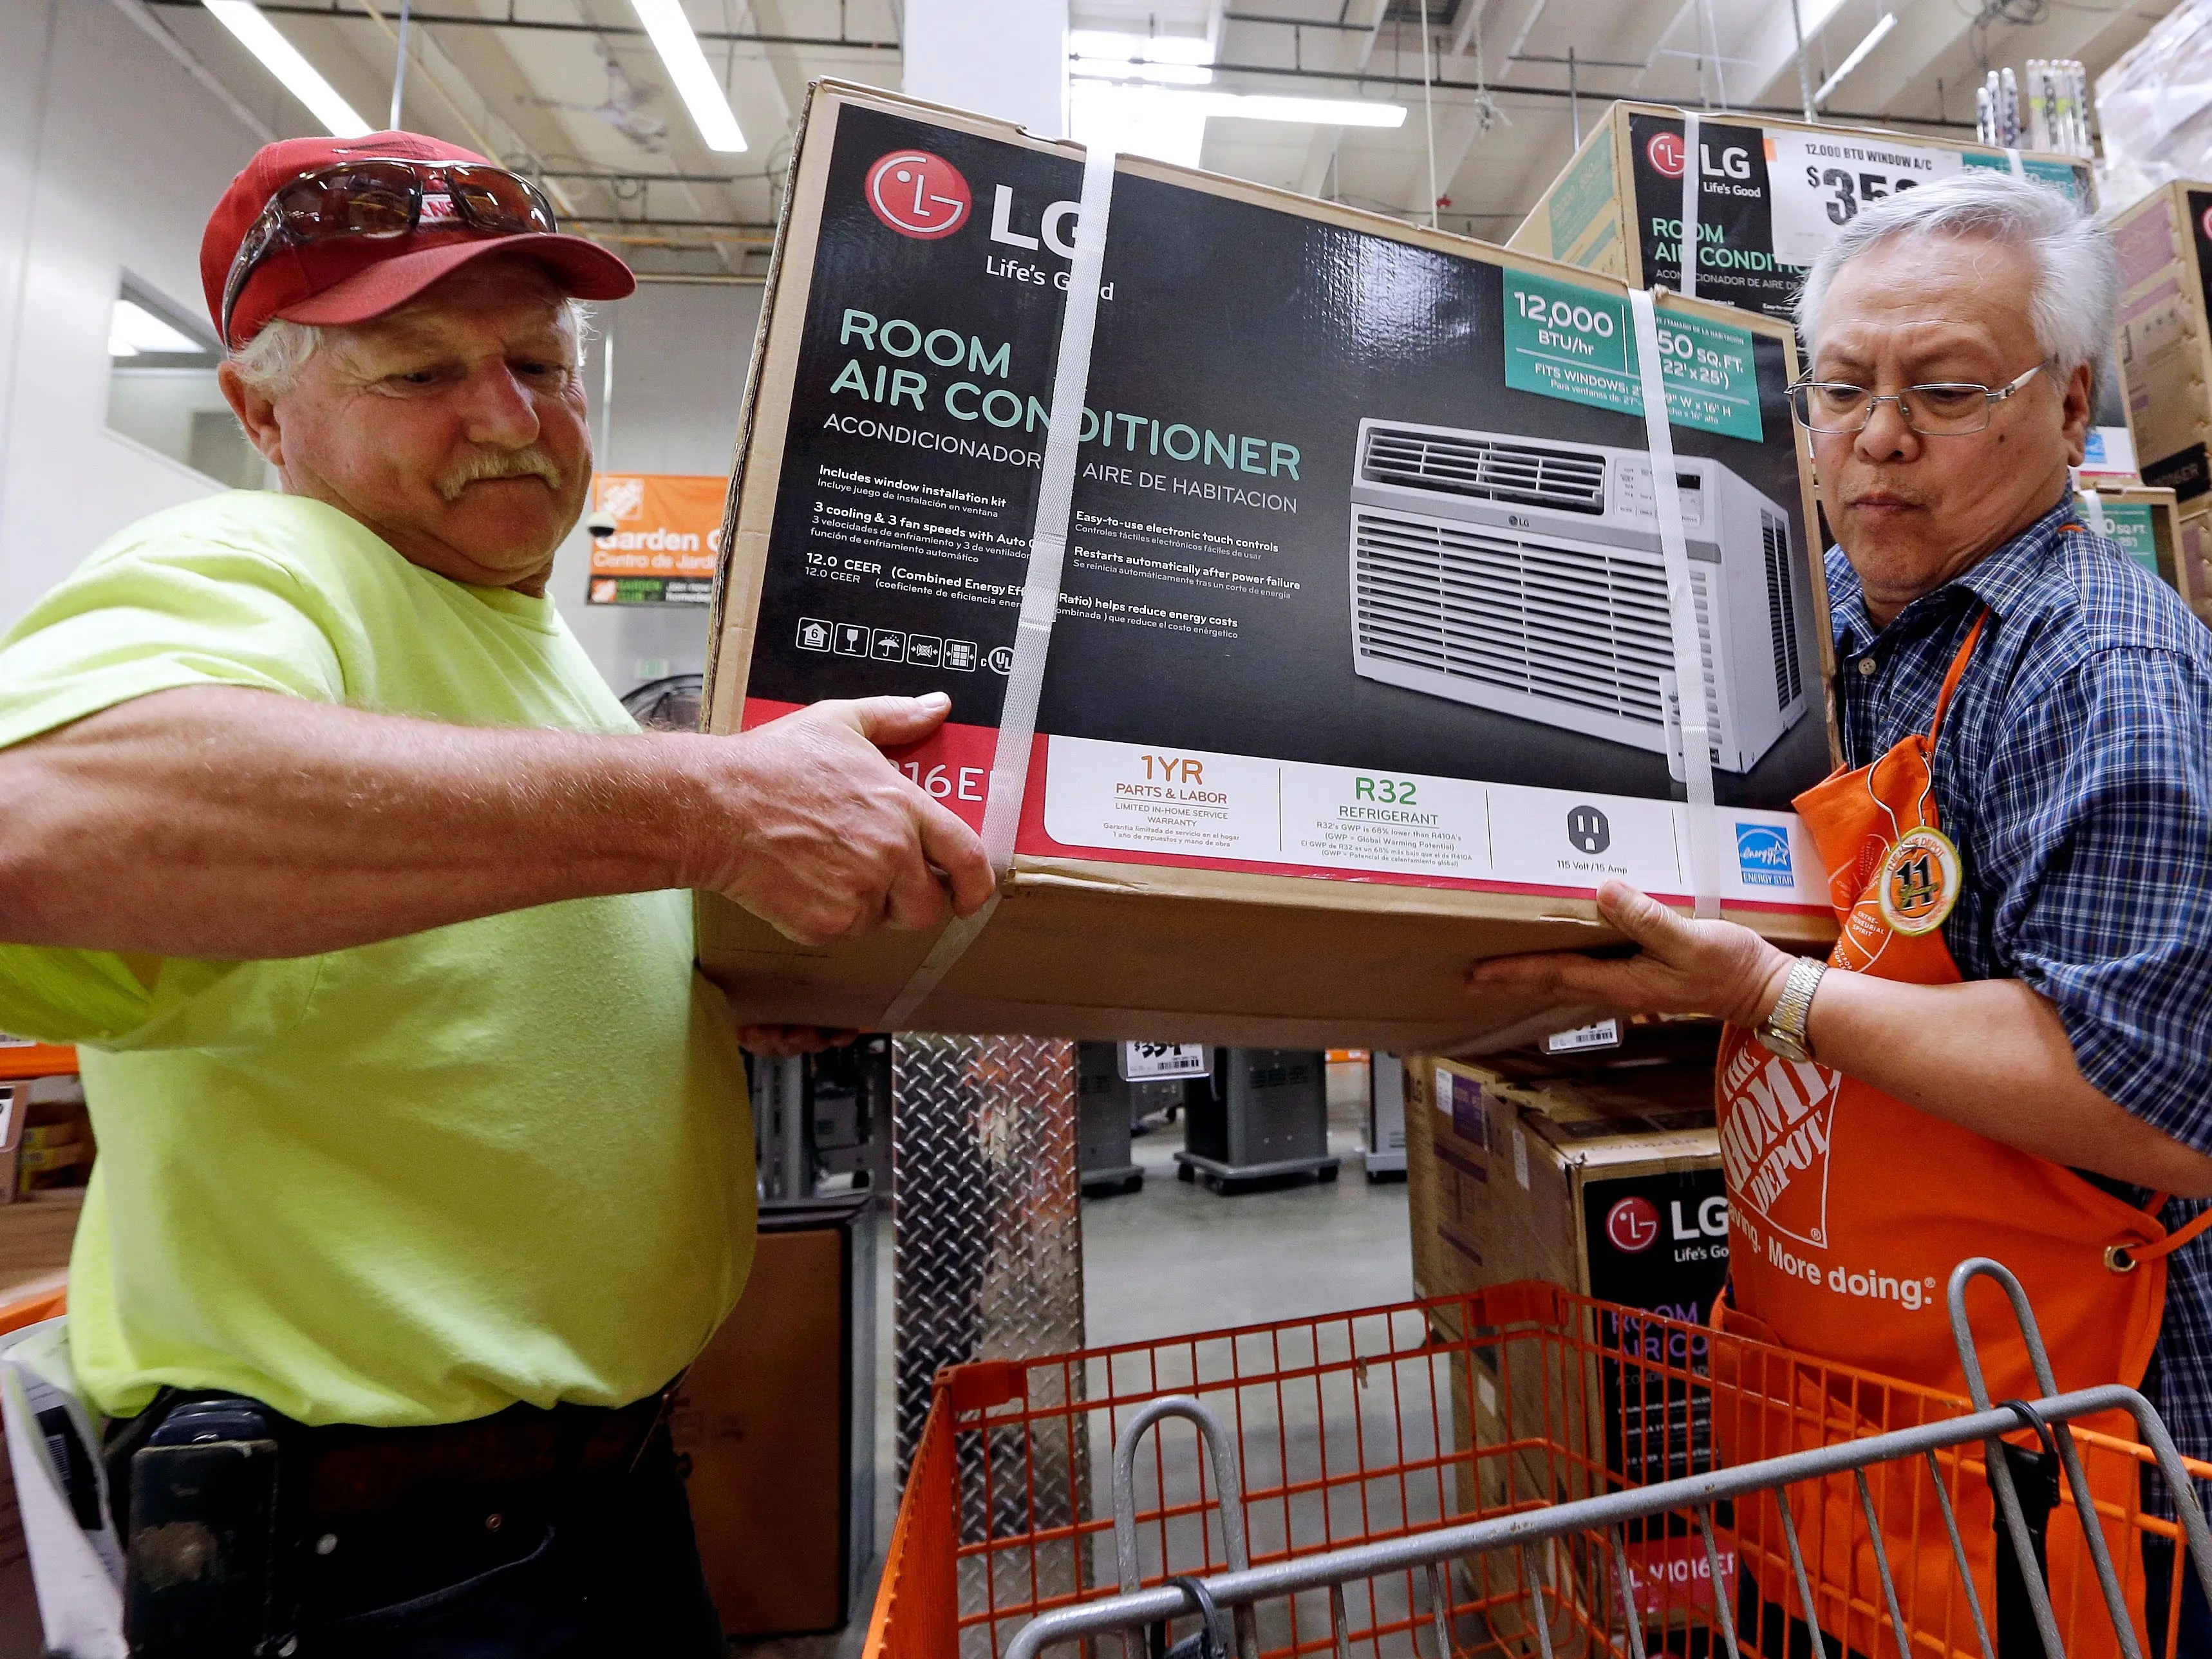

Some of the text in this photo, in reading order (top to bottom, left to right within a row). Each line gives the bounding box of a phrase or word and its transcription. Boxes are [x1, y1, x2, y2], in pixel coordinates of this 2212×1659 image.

[1700, 143, 1751, 180] LG
[1844, 148, 1864, 160] BTU
[1866, 150, 1911, 167] WINDOW
[1913, 158, 1933, 171] A/C
[1703, 181, 1761, 198] Life's Good
[986, 256, 1114, 302] Life's Gd
[1762, 279, 1784, 290] AIRE
[840, 308, 1011, 379] ROOM
[1514, 291, 1613, 338] 12,000
[1658, 329, 1694, 360] 50
[1538, 329, 1595, 356] BTU/hr
[830, 359, 927, 411] AIR
[1535, 362, 1561, 379] FITS
[1680, 396, 1692, 408] W
[823, 413, 1297, 514] ACONDICIONADOR AIRE DE HABITACION
[818, 478, 852, 492] Incluye
[852, 485, 881, 498] juego
[883, 491, 895, 500] de
[897, 493, 947, 509] instalación
[962, 507, 998, 518] ventana
[820, 464, 1007, 507] Includes window installation kit
[812, 515, 820, 524] 3
[821, 518, 878, 535] velocidades
[879, 528, 892, 537] de
[894, 532, 954, 548] enfriamiento
[963, 541, 970, 550] 3
[971, 543, 984, 552] de
[814, 501, 823, 512] 3
[826, 507, 872, 523] cooling
[874, 512, 885, 523] &
[888, 515, 897, 525] 3
[900, 517, 921, 530] fan
[923, 523, 966, 538] speeds
[968, 530, 994, 542] with
[996, 534, 1026, 547] Auto
[1074, 523, 1261, 561] Controles táctiles electrónicos fáciles de usar
[1076, 511, 1279, 552] Easy-to-use electronic touch controls
[810, 528, 979, 563] función de enfriamiento automático
[1073, 559, 1085, 568] Se
[1087, 563, 1118, 573] reinicia
[1119, 568, 1194, 585] automáticamente
[1196, 579, 1212, 587] tras
[1226, 584, 1248, 593] corte
[1248, 586, 1259, 595] de
[1074, 546, 1300, 590] Restarts automatically after power failure
[805, 567, 828, 578] 12.0
[830, 571, 861, 583] CEER
[876, 578, 933, 595] (coeficiente
[935, 588, 948, 597] de
[951, 591, 996, 605] eficiencia
[1109, 615, 1125, 624] que
[1127, 617, 1157, 628] reduce
[1168, 623, 1192, 632] costo
[807, 552, 838, 567] 12.0
[844, 559, 881, 574] CEER
[892, 567, 961, 587] (Combined
[965, 578, 1006, 596] Energy
[1059, 592, 1092, 608] Ratio)
[1094, 597, 1125, 612] helps
[1128, 605, 1167, 618] reduce
[1169, 611, 1207, 625] energy
[1208, 615, 1238, 628] costs
[1141, 755, 1203, 785] 1YR
[1116, 783, 1228, 804] PARTS & LABOR
[1355, 776, 1417, 805] R32
[1115, 802, 1228, 820] LIMITED IN-HOME SERVICE
[1147, 816, 1197, 827] WARRANTY
[1339, 805, 1438, 825] REFRIGERANT
[1357, 835, 1382, 844] Global
[1383, 838, 1417, 848] Warming
[1391, 829, 1411, 838] lower
[1557, 859, 1571, 869] 115
[1608, 864, 1627, 876] Amp
[1750, 1110, 1828, 1215] DEPOT
[1671, 1195, 1729, 1241] LG
[1674, 1244, 1730, 1262] Life's Go
[1768, 1235, 1822, 1285] More
